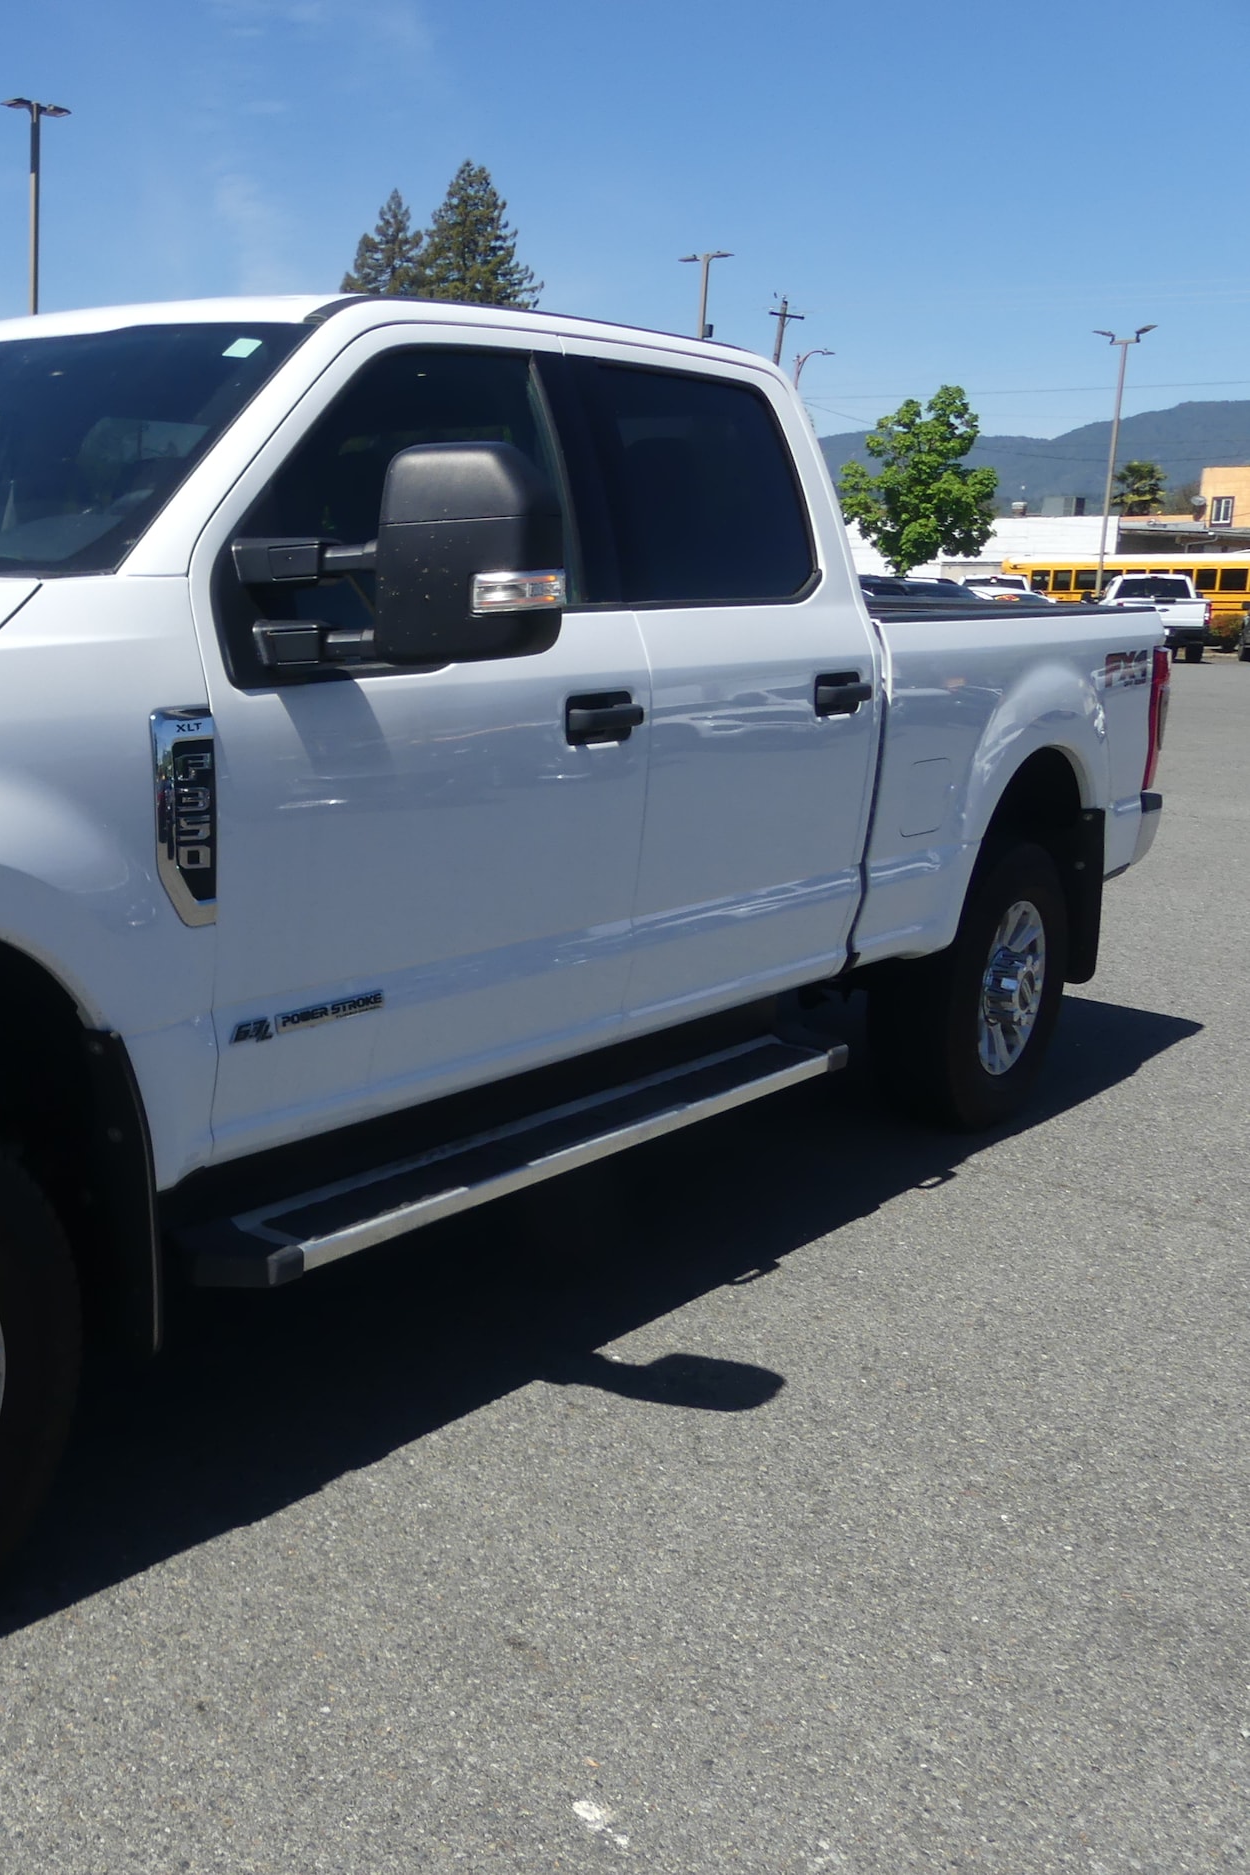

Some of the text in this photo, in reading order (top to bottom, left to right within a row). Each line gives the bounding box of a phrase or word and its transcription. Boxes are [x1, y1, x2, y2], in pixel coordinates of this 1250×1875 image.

[1105, 649, 1147, 688] FX4
[176, 722, 202, 733] XLT
[282, 1007, 328, 1027] POWER
[331, 993, 383, 1015] STROKE
